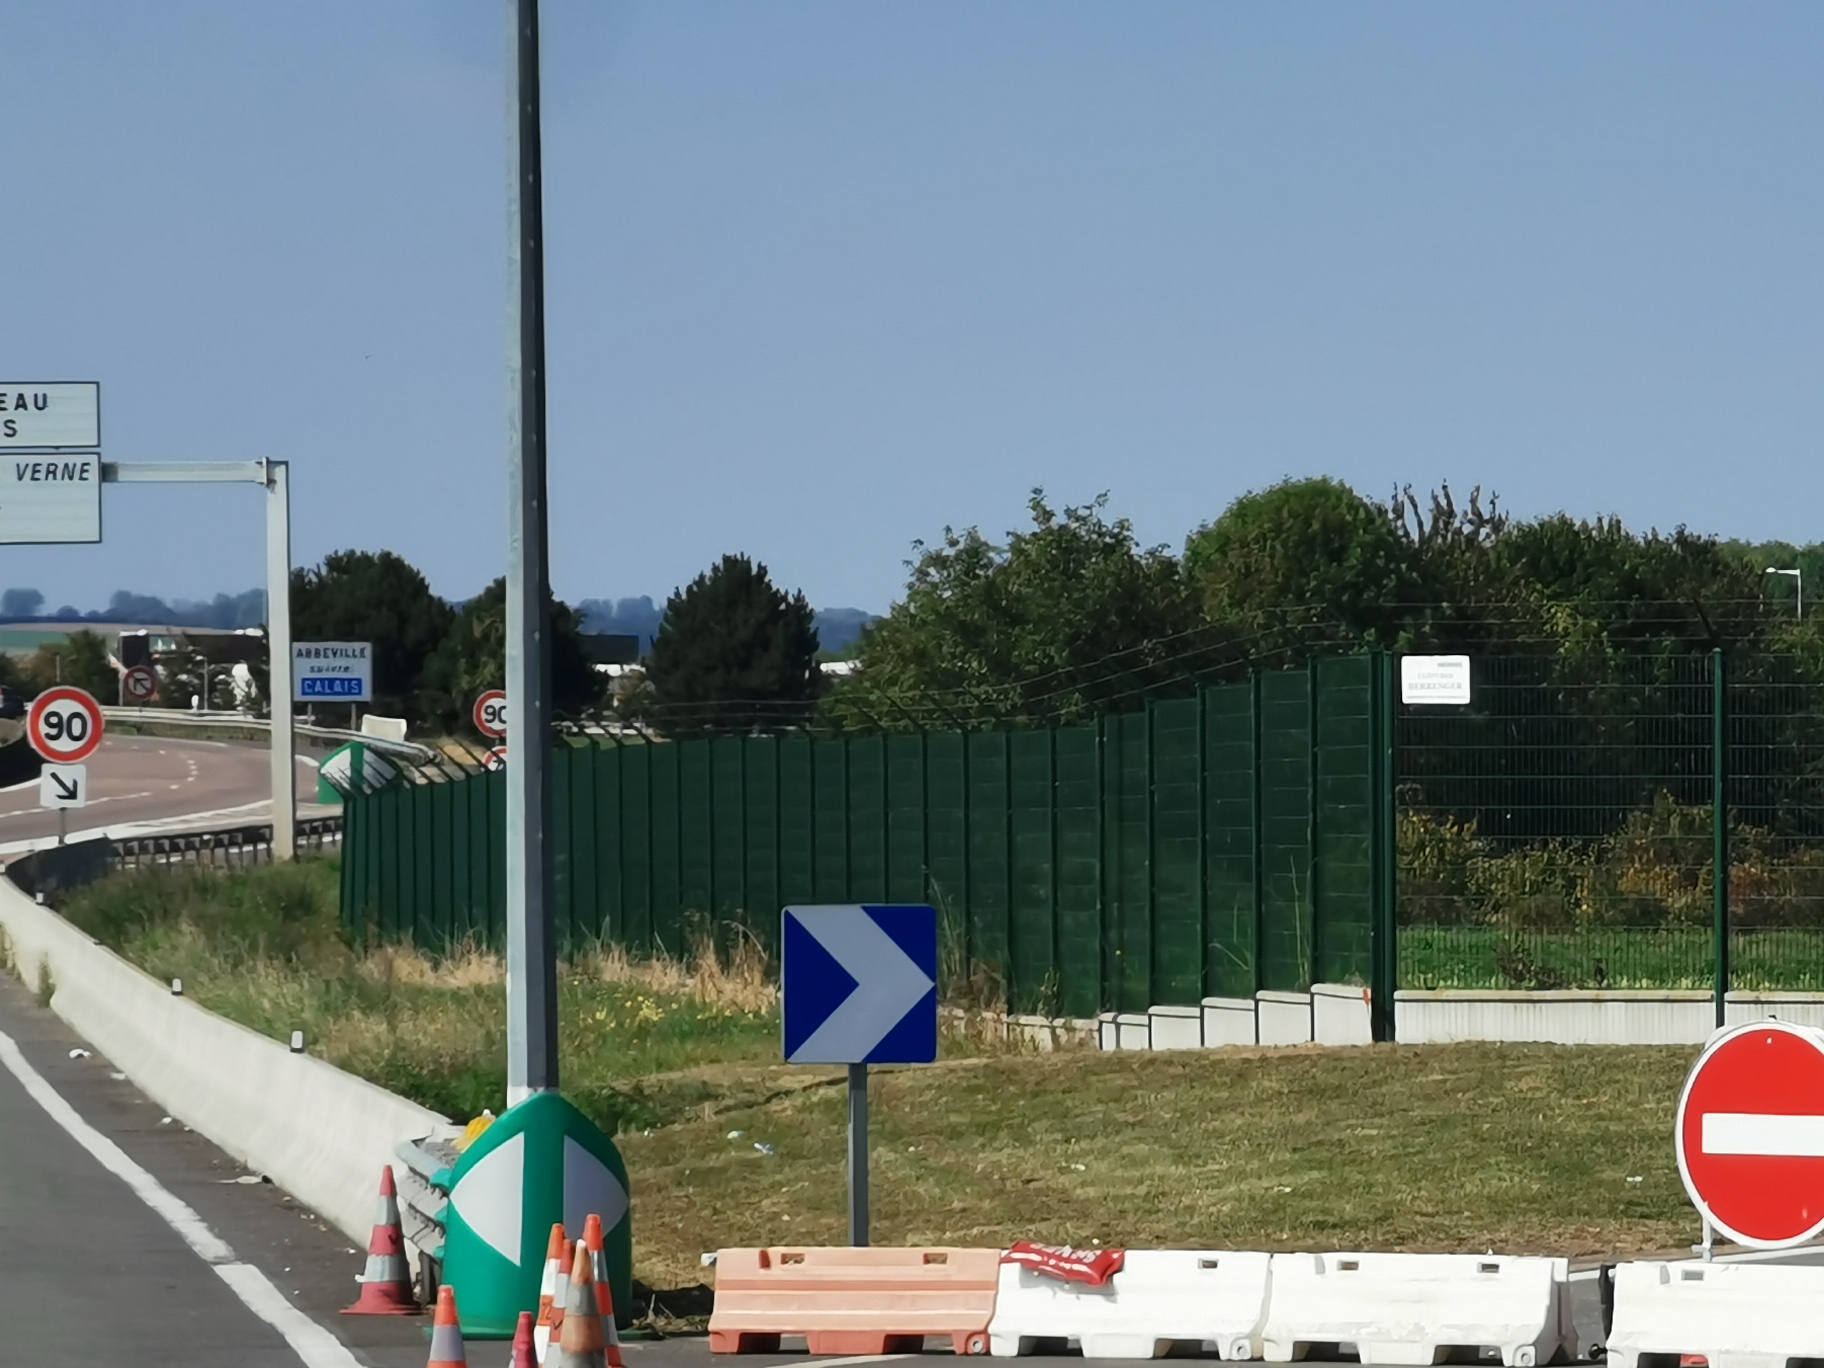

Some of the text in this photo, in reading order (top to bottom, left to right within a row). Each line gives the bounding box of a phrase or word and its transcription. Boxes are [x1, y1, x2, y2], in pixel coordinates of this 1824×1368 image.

[16, 462, 91, 481] VERNE
[296, 647, 366, 659] ABBEVILLE
[304, 680, 360, 694] CALAIS
[484, 704, 507, 725] 90
[44, 711, 88, 742] 90
